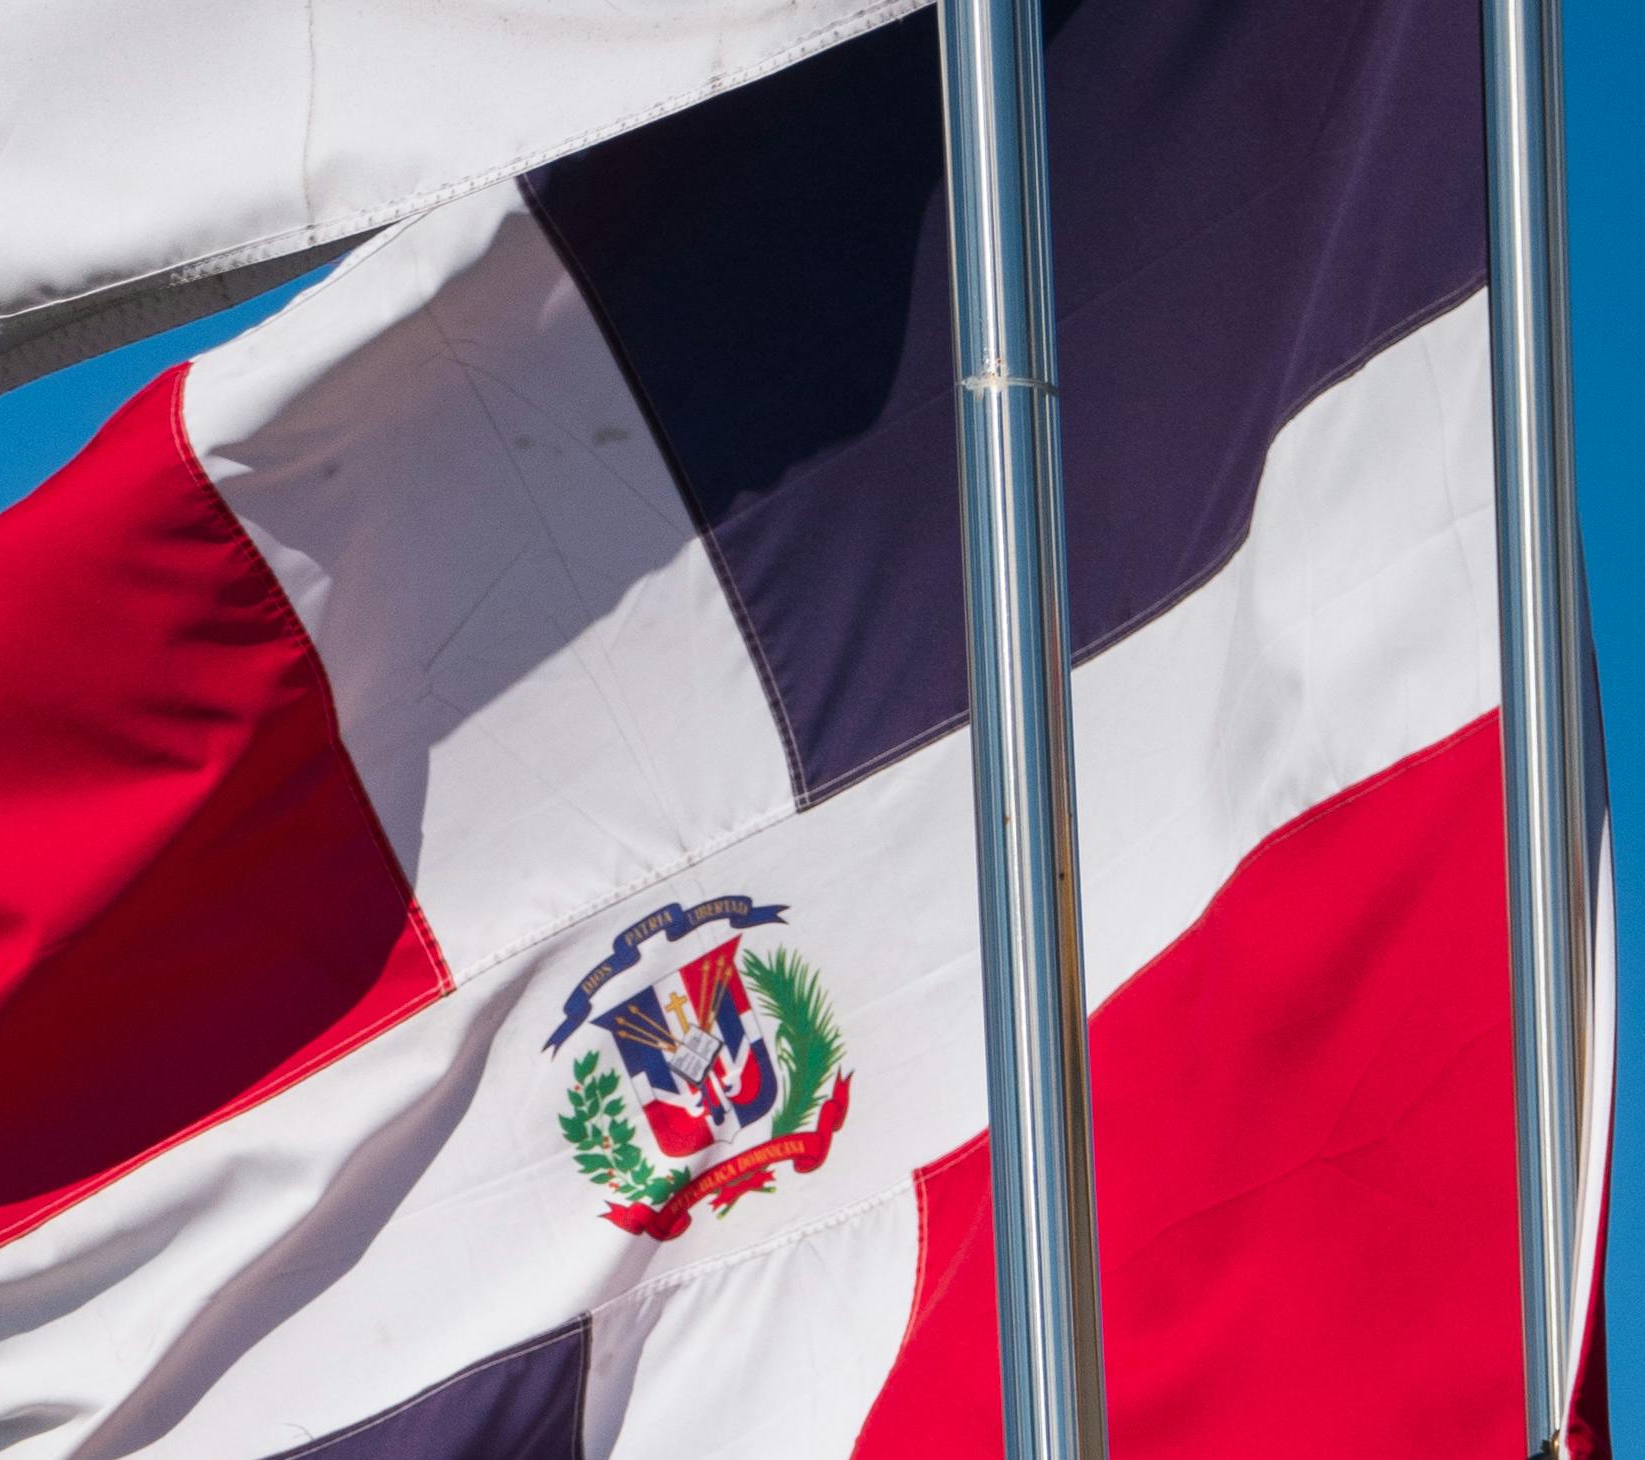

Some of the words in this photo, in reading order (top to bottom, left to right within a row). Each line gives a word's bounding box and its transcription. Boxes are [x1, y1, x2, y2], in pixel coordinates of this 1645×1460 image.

[582, 966, 612, 993] DIOS
[626, 911, 673, 945] PATRIA
[687, 900, 748, 925] LIBERTAD
